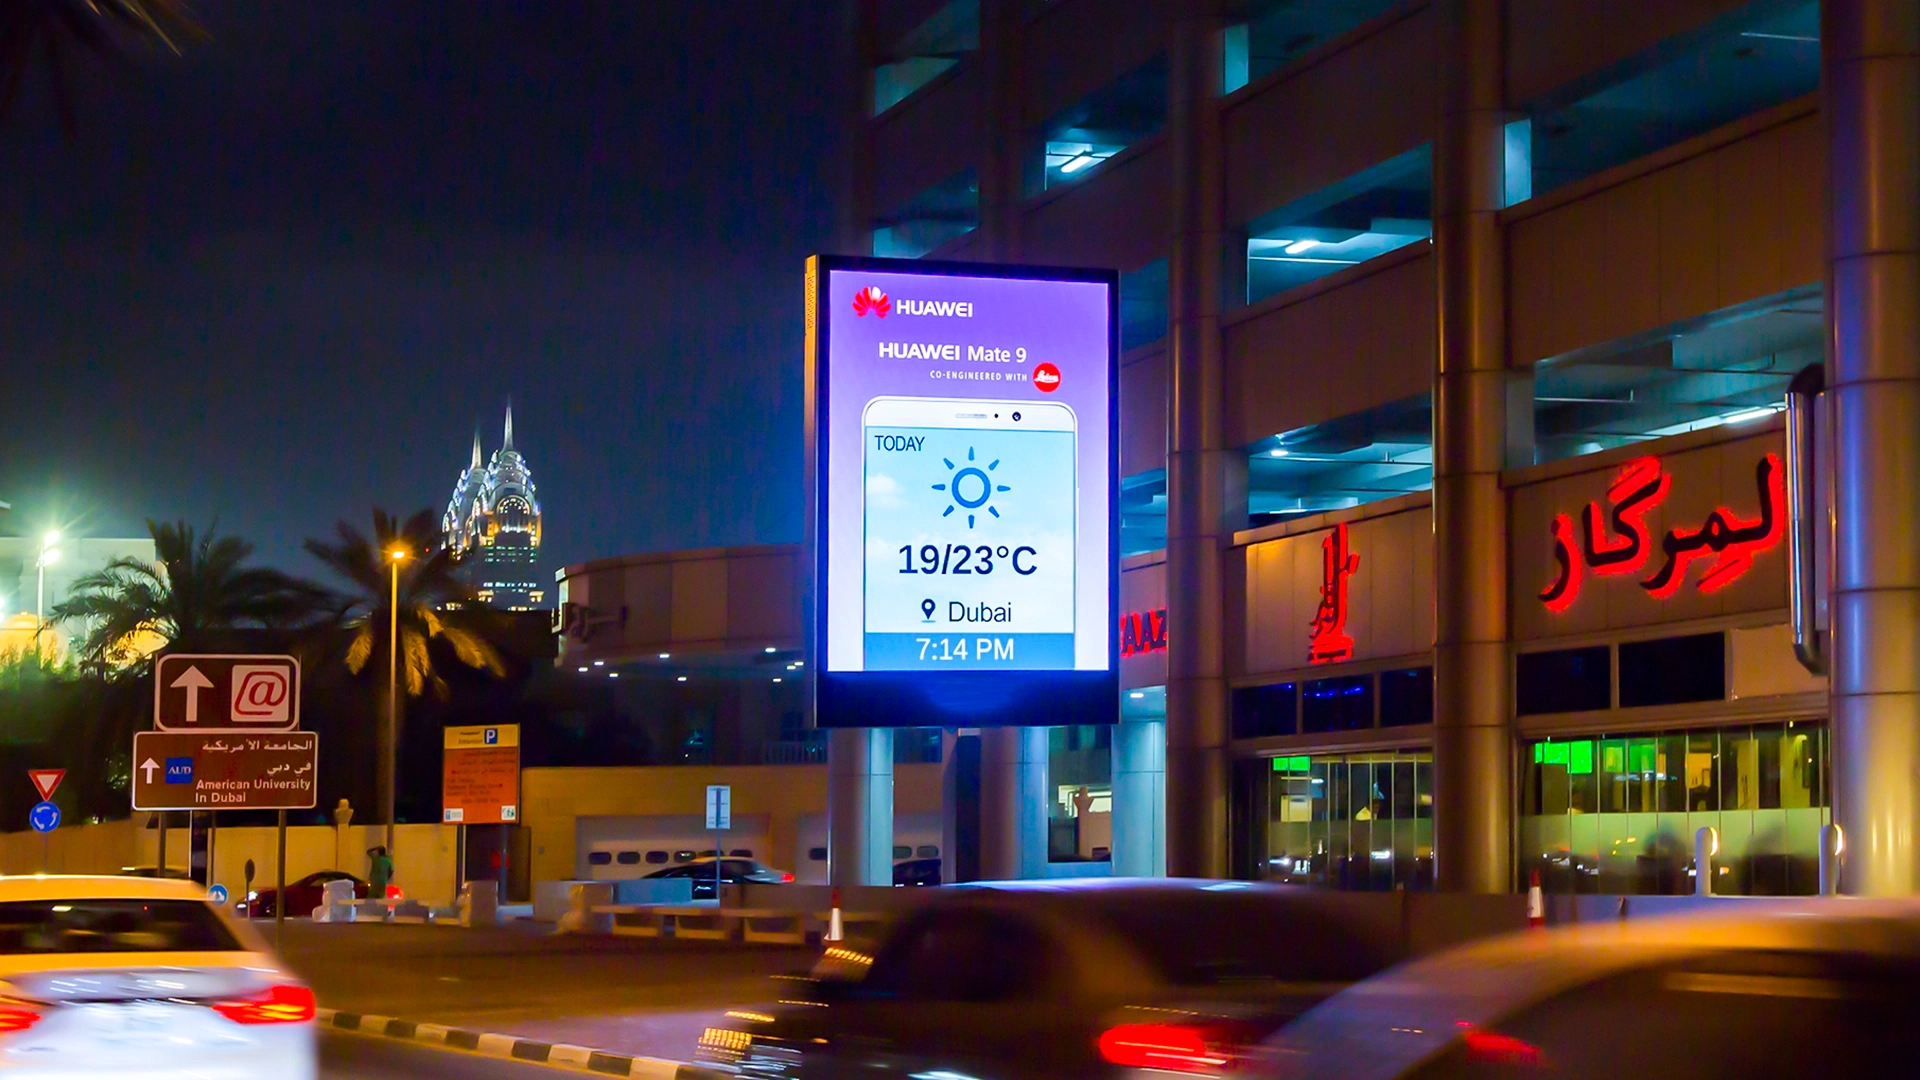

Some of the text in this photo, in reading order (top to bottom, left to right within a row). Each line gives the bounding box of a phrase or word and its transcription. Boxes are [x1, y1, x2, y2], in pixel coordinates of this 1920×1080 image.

[896, 299, 973, 318] HUAWEI
[878, 342, 1027, 363] HUAWEI Mate 9
[929, 369, 1028, 382] CO-ENGINEERED WITH
[874, 434, 925, 452] TODAY
[898, 544, 1038, 576] 19/23°C
[948, 601, 1012, 623] Dubai
[916, 638, 1015, 661] 7:14 PM
[263, 740, 312, 753] الجامعة
[168, 766, 192, 775] AUD
[266, 761, 312, 777] في دبي
[196, 779, 311, 791] American University
[195, 792, 246, 803] In Dubai
